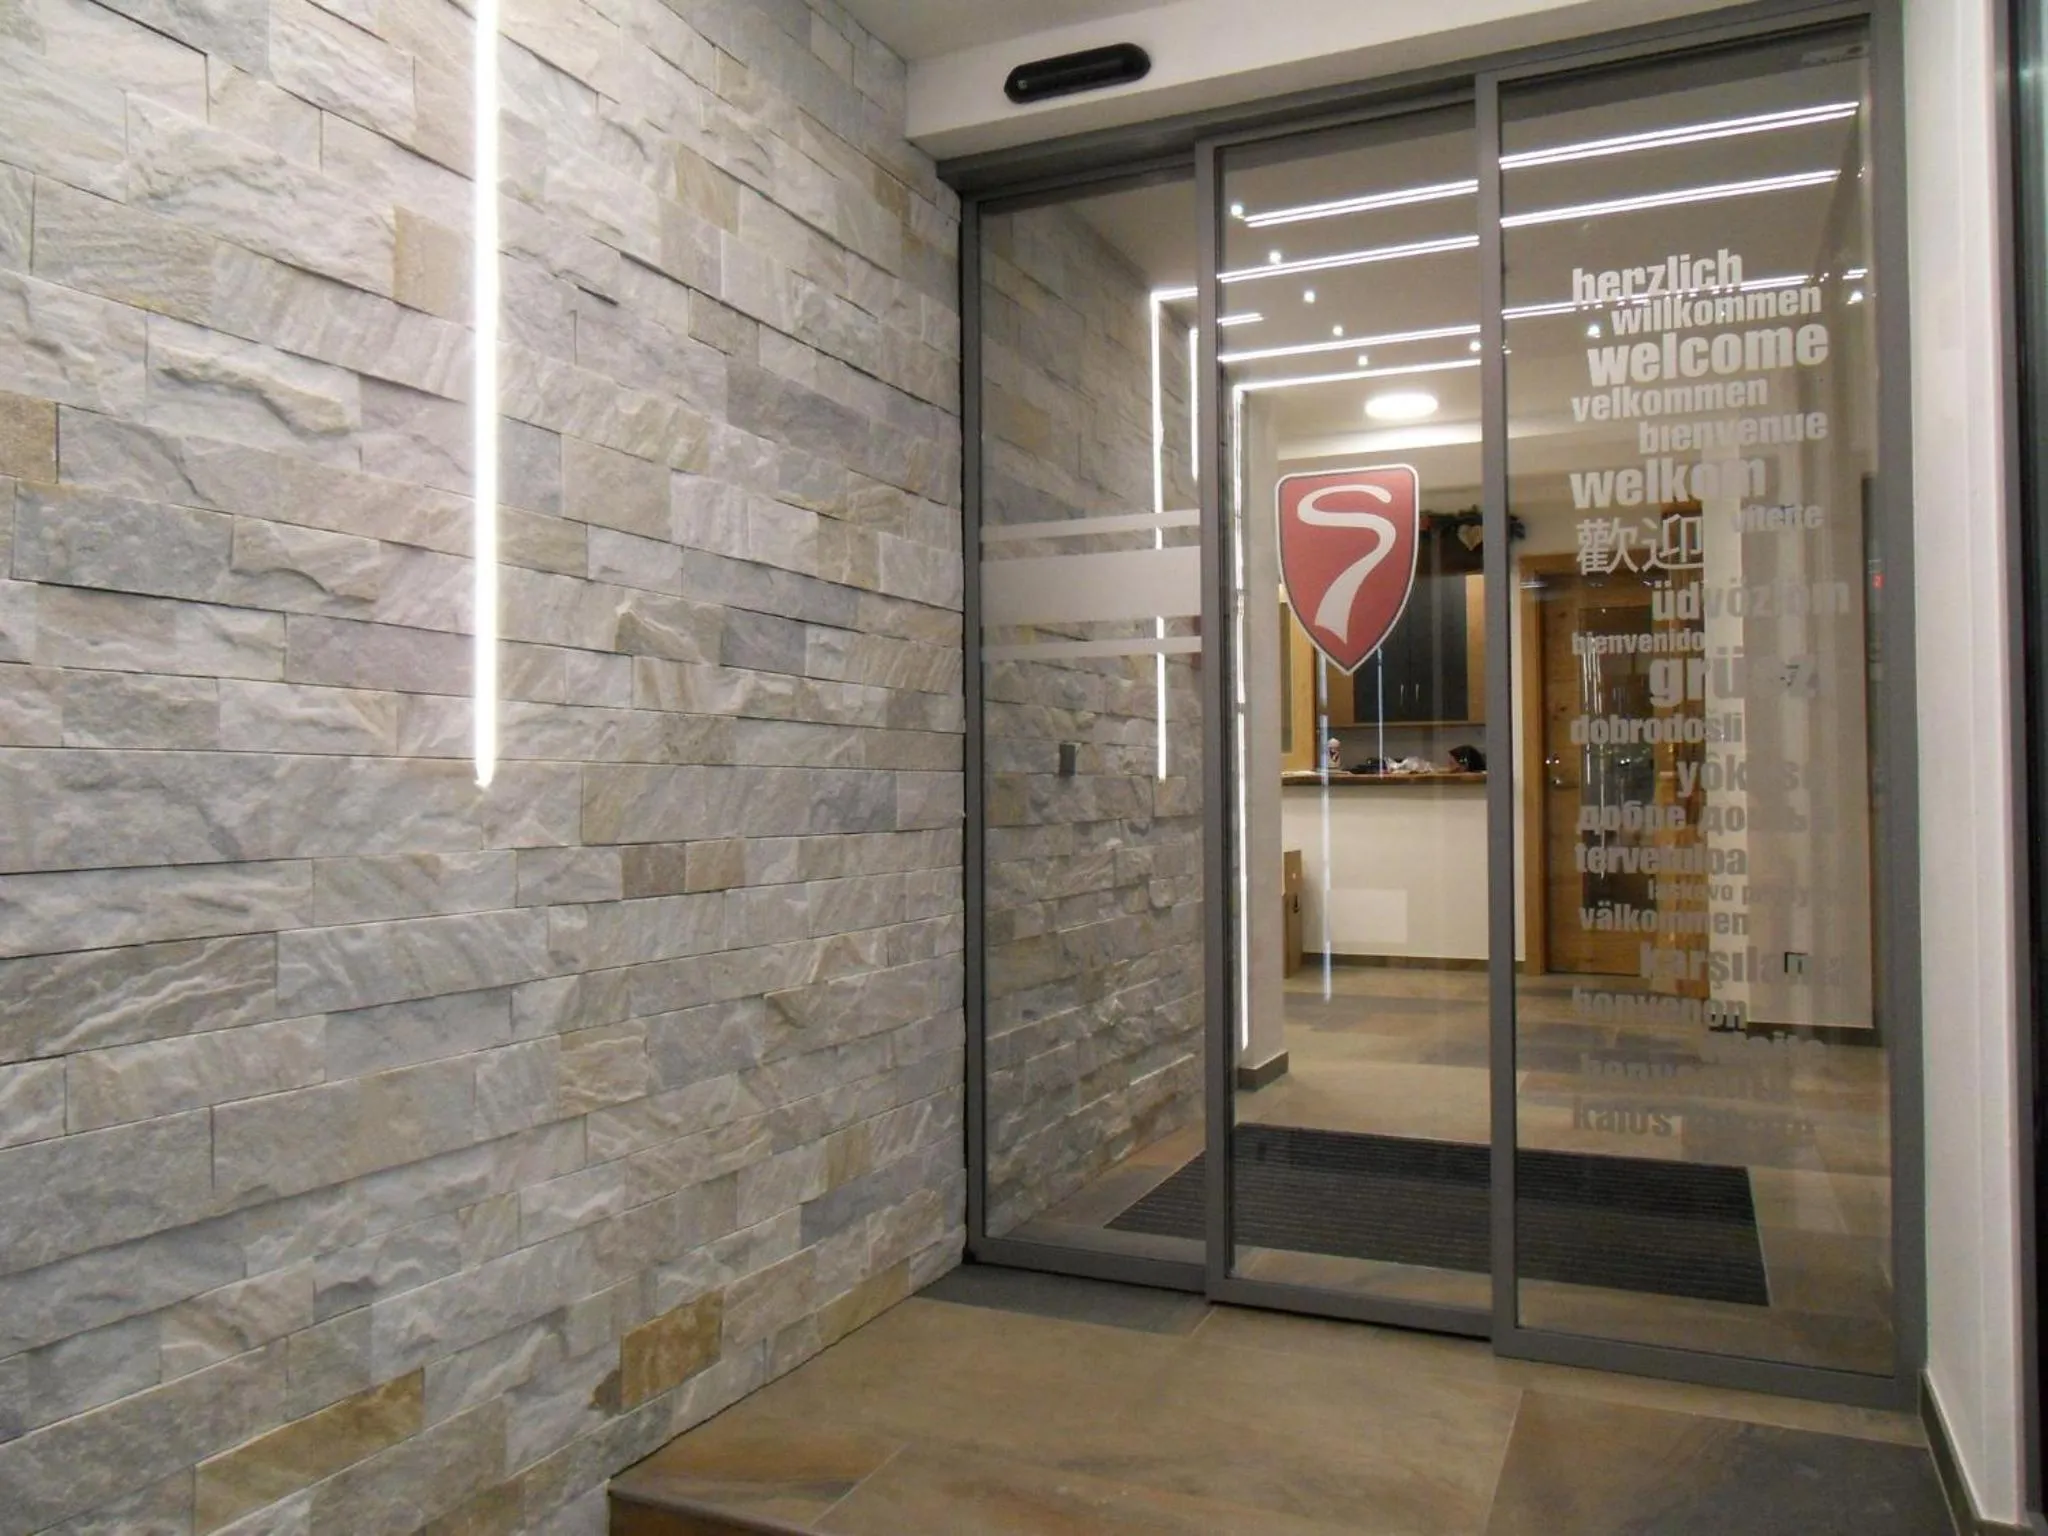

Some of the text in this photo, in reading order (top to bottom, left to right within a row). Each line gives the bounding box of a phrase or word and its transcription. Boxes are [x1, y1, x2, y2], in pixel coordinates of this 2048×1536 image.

[1573, 249, 1743, 304] herzlich
[1612, 286, 1822, 336] willkommen
[1589, 323, 1829, 387] welcome
[1572, 378, 1768, 422] velkommen
[1640, 411, 1829, 453] bienvenue
[1571, 457, 1767, 509] welkom
[1577, 513, 1704, 576] 歡迎
[1572, 628, 1706, 655] bienvenido
[1571, 708, 1743, 745] dobrodošli
[1575, 841, 1747, 877] tervetuloa
[1579, 900, 1750, 937] välkommen
